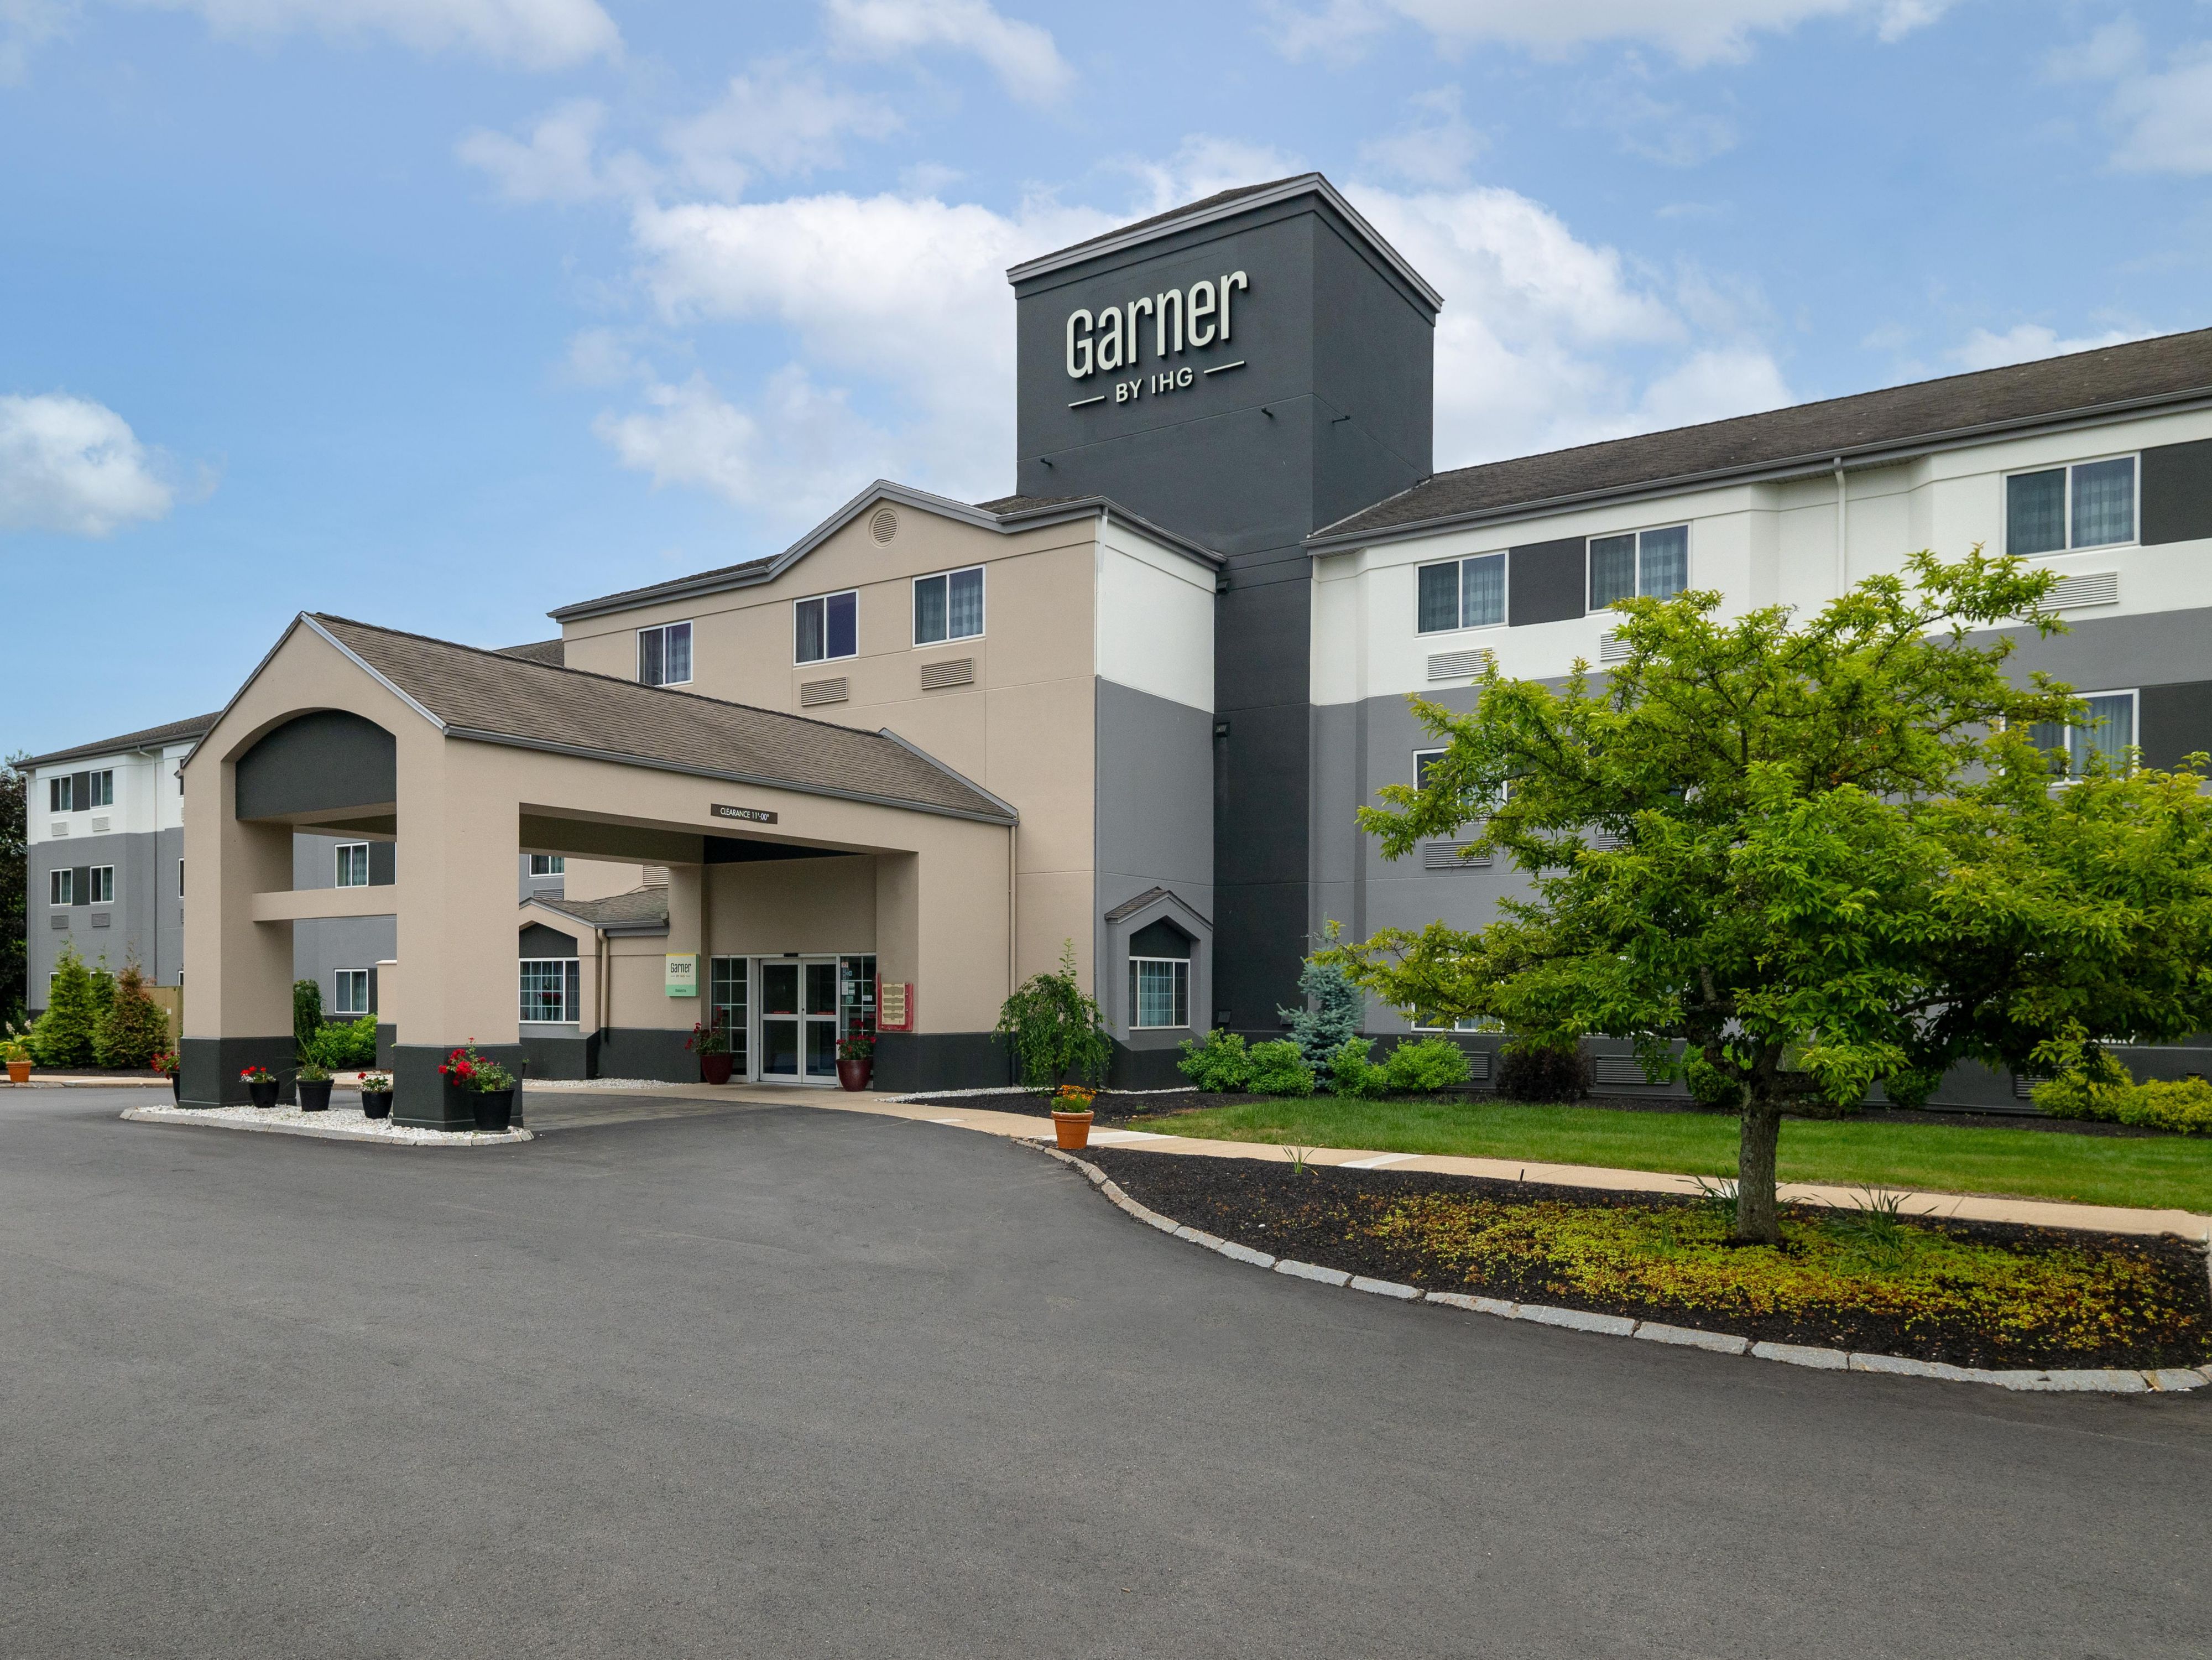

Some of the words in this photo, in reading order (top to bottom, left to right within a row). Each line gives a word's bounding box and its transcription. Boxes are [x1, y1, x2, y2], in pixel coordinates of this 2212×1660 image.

[1066, 270, 1248, 379] Garner
[1116, 378, 1144, 403] BY
[1151, 367, 1193, 394] IHG
[720, 807, 750, 818] CLEARANCE
[670, 962, 691, 973] Garner
